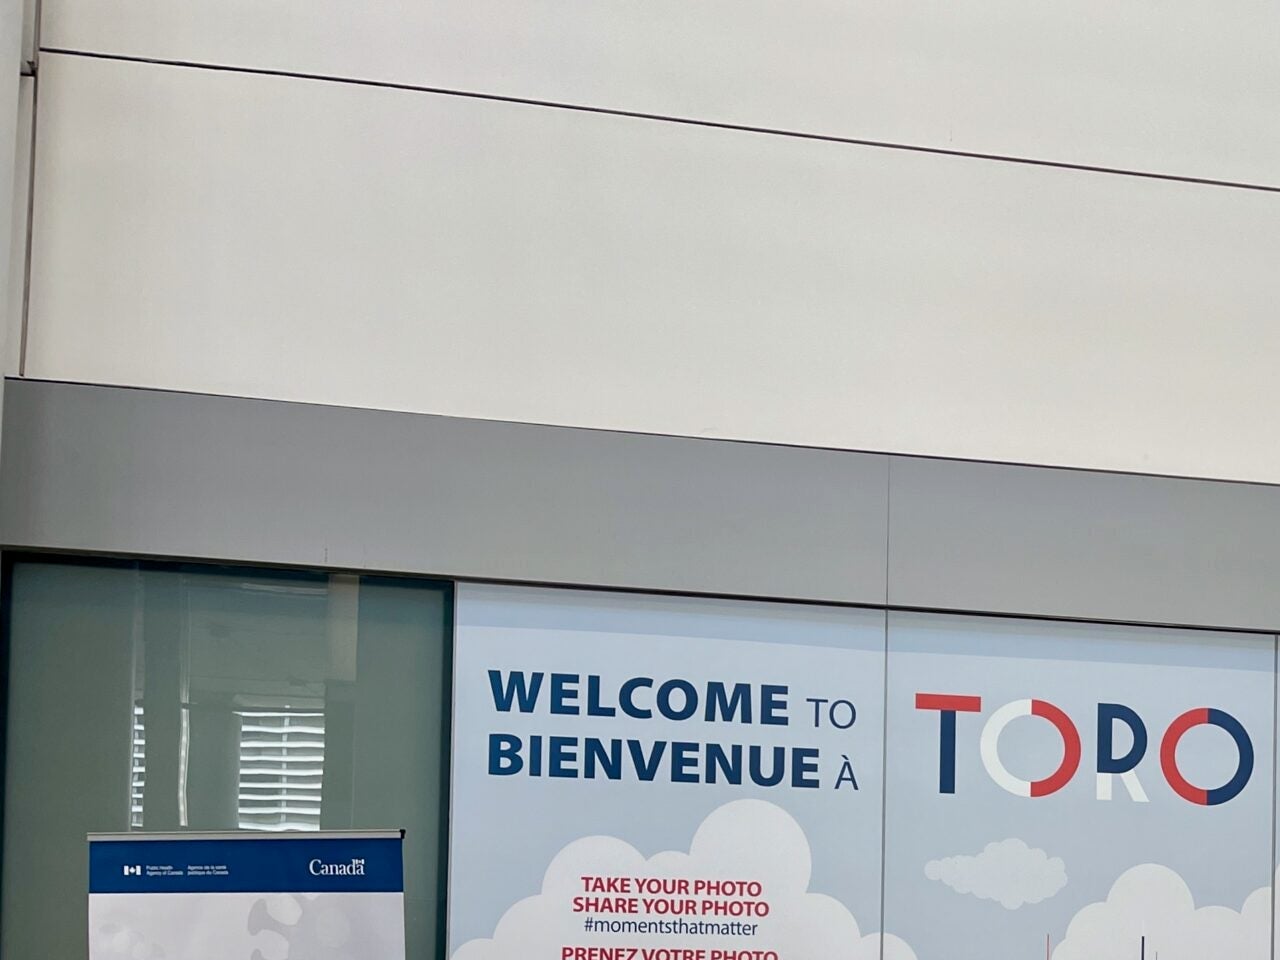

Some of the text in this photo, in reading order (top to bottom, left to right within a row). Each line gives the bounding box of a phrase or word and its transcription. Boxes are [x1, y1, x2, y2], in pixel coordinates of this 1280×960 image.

[488, 670, 856, 729] WELCOME TO
[488, 734, 858, 790] BIENVENUE À
[309, 859, 364, 875] Canada
[581, 877, 762, 897] TAKE YOUR PHOTO
[573, 897, 769, 917] SHARE YOUR PHOTO
[584, 918, 758, 935] #momentsthatmatter
